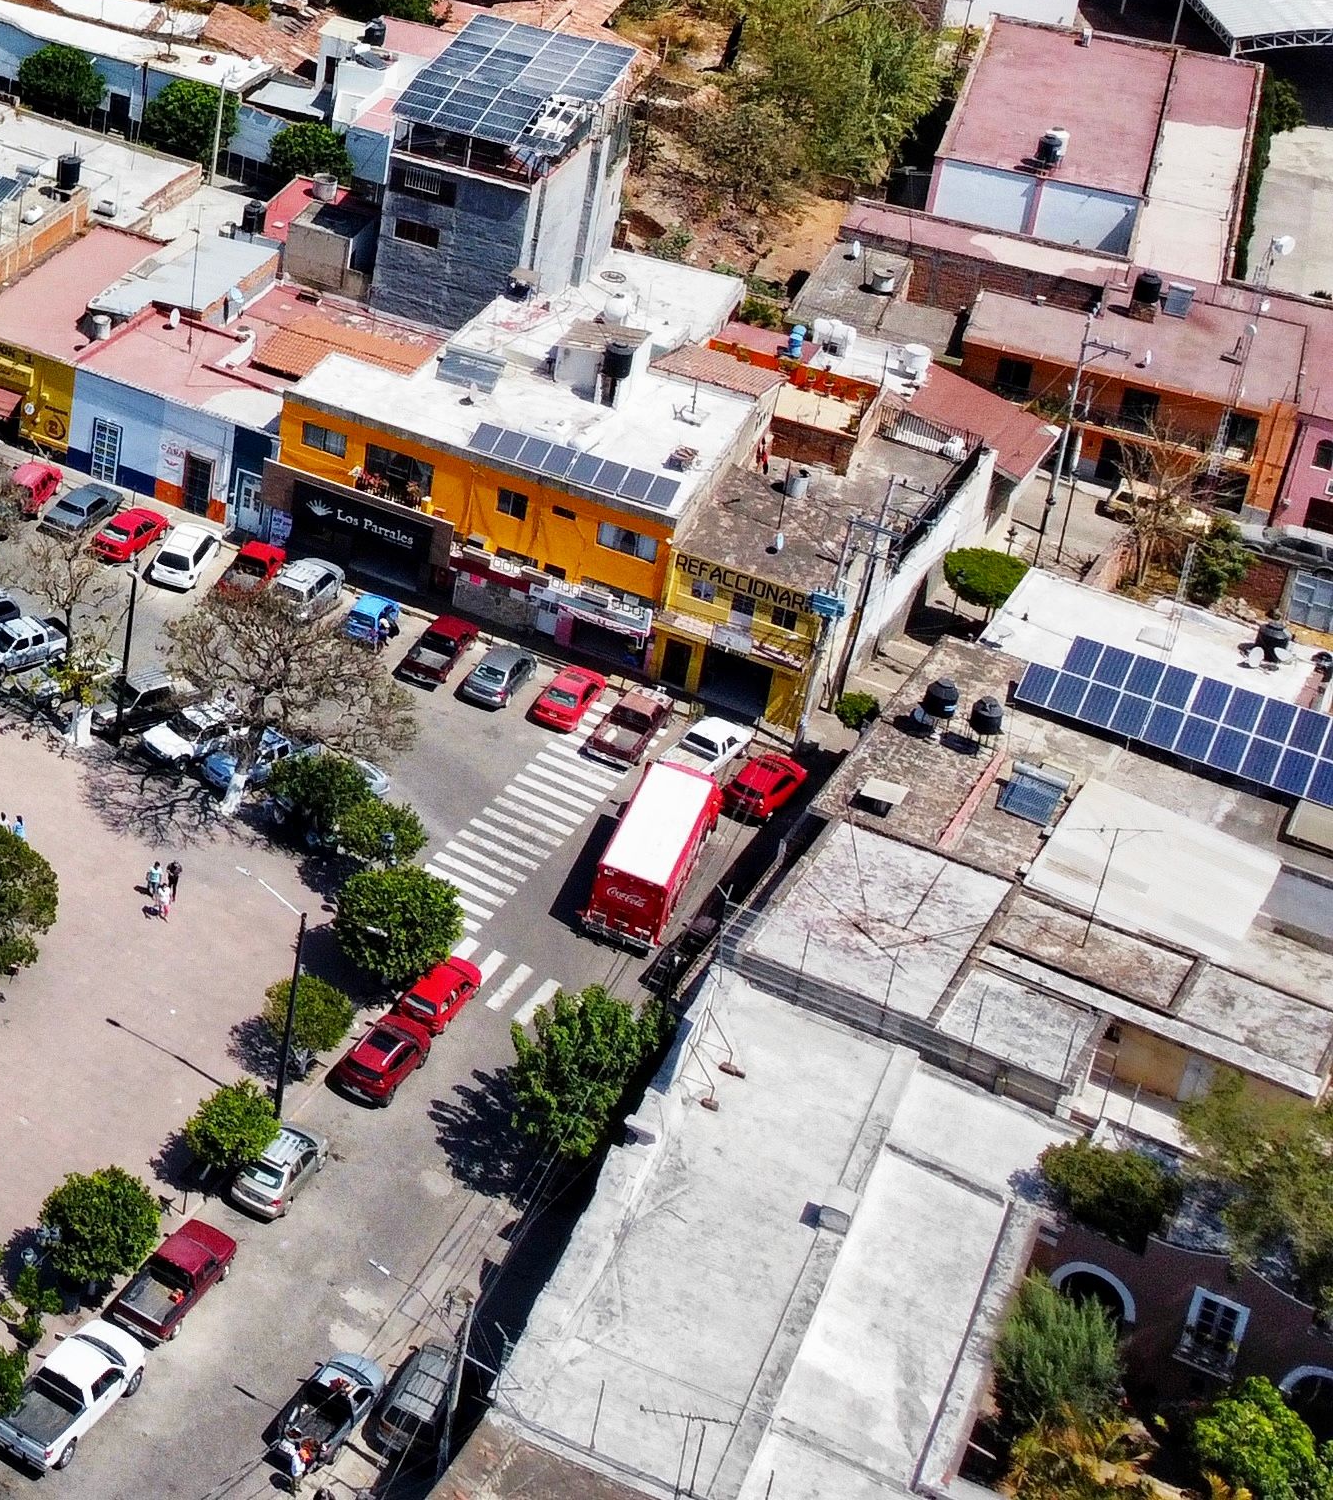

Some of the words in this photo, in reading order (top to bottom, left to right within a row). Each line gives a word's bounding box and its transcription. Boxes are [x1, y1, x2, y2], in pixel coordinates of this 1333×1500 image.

[336, 508, 359, 527] Los
[363, 518, 414, 546] Parrales
[606, 886, 649, 908] Coca-Cola
